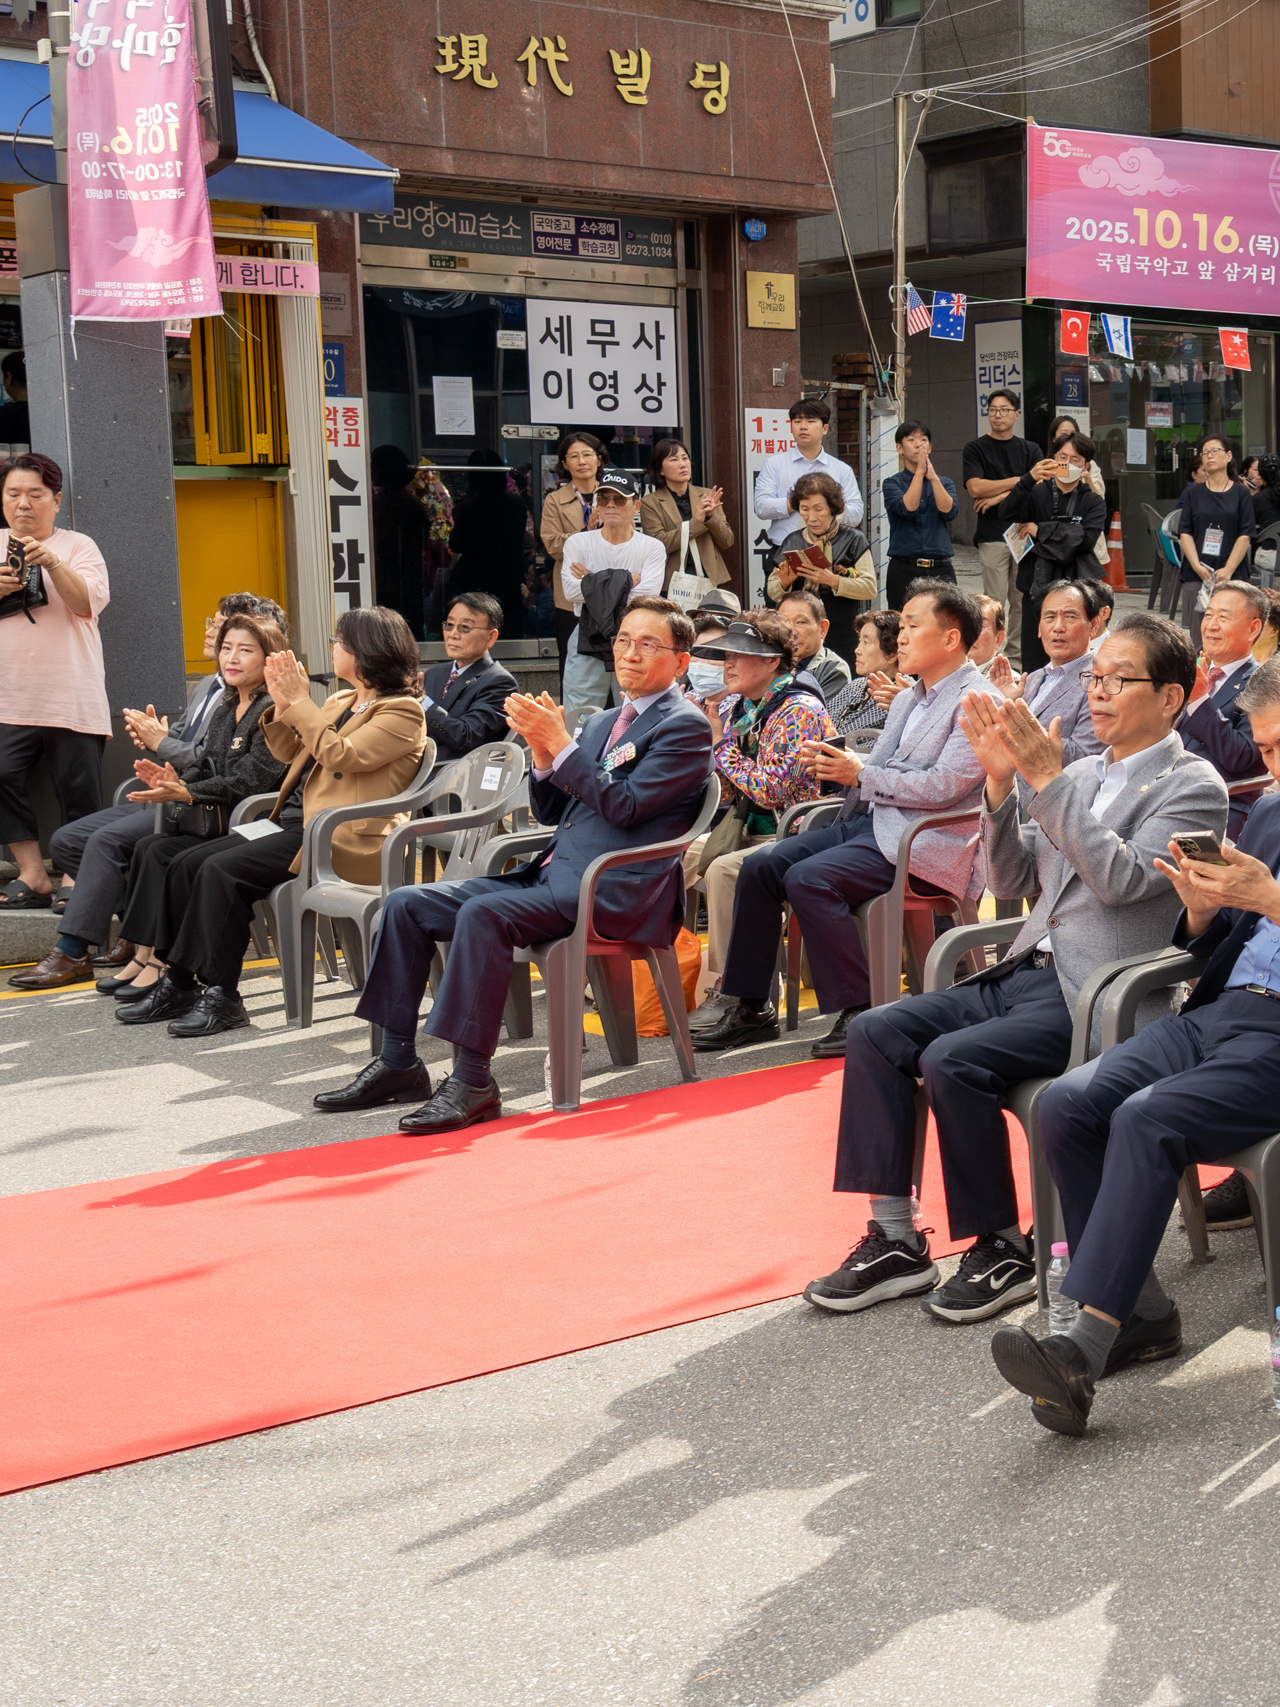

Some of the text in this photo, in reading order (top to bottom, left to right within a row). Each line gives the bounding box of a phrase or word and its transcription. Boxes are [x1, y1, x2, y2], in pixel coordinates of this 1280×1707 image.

[434, 33, 730, 115] 現代 빌딩
[535, 217, 615, 236] 국악중고 소수정예
[482, 242, 522, 252] ENGLISH
[536, 235, 616, 255] 영어전문 학습코칭
[650, 232, 672, 245] (010)
[1248, 235, 1280, 258] (목)
[625, 244, 673, 257] 6273.1034
[240, 262, 304, 289] 합니다.
[1095, 252, 1189, 277] 국립국악고
[1198, 260, 1216, 281] 앞
[1222, 263, 1276, 286] 삼거리
[538, 314, 666, 361] 세무사
[978, 364, 1021, 389] 리더스
[542, 368, 667, 413] 이영상
[1067, 383, 1079, 398] 28
